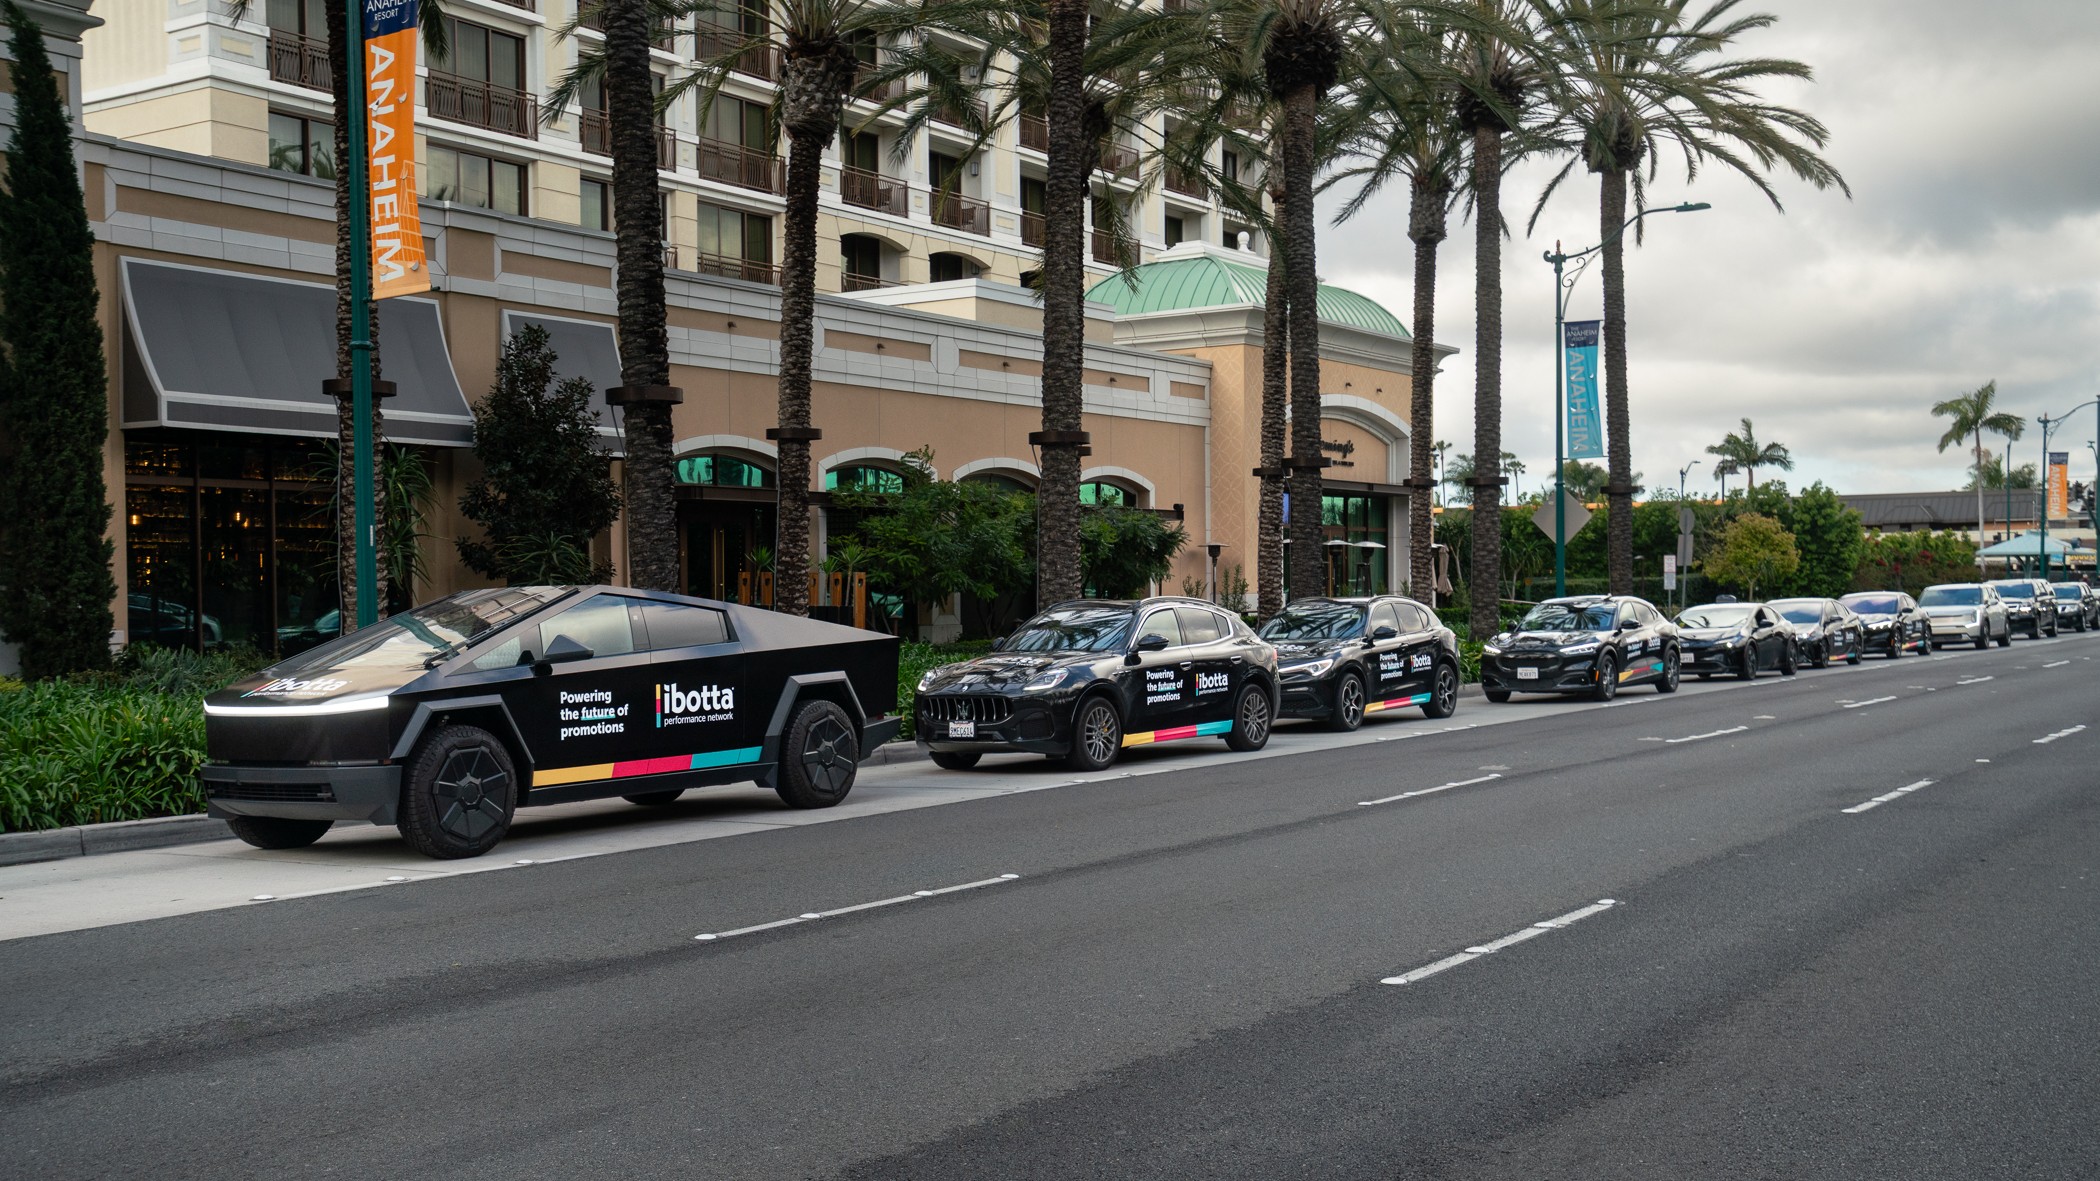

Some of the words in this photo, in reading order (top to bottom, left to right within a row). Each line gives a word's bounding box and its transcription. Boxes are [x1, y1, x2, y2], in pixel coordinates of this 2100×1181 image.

[374, 8, 399, 20] RESORT
[370, 44, 405, 283] ANAHEIM
[1566, 329, 1598, 338] ANAHEIM
[1568, 350, 1590, 453] ANAHEIM
[2049, 465, 2061, 516] ANAHEIM
[1380, 652, 1397, 661] Powering
[1414, 655, 1431, 667] ibotta
[1146, 670, 1174, 680] Powering
[1199, 672, 1228, 689] ibotta
[1381, 670, 1402, 681] promotions
[259, 677, 350, 692] ibotta
[1146, 683, 1158, 692] the
[1158, 681, 1176, 691] future
[1176, 679, 1183, 688] of
[560, 690, 612, 704] Powering
[663, 683, 734, 714] ibotta
[1146, 692, 1181, 706] promotions
[560, 708, 579, 721] the
[581, 705, 615, 720] future
[617, 703, 629, 717] of
[663, 715, 707, 728] performance
[707, 711, 734, 722] network
[560, 721, 625, 740] promotions
